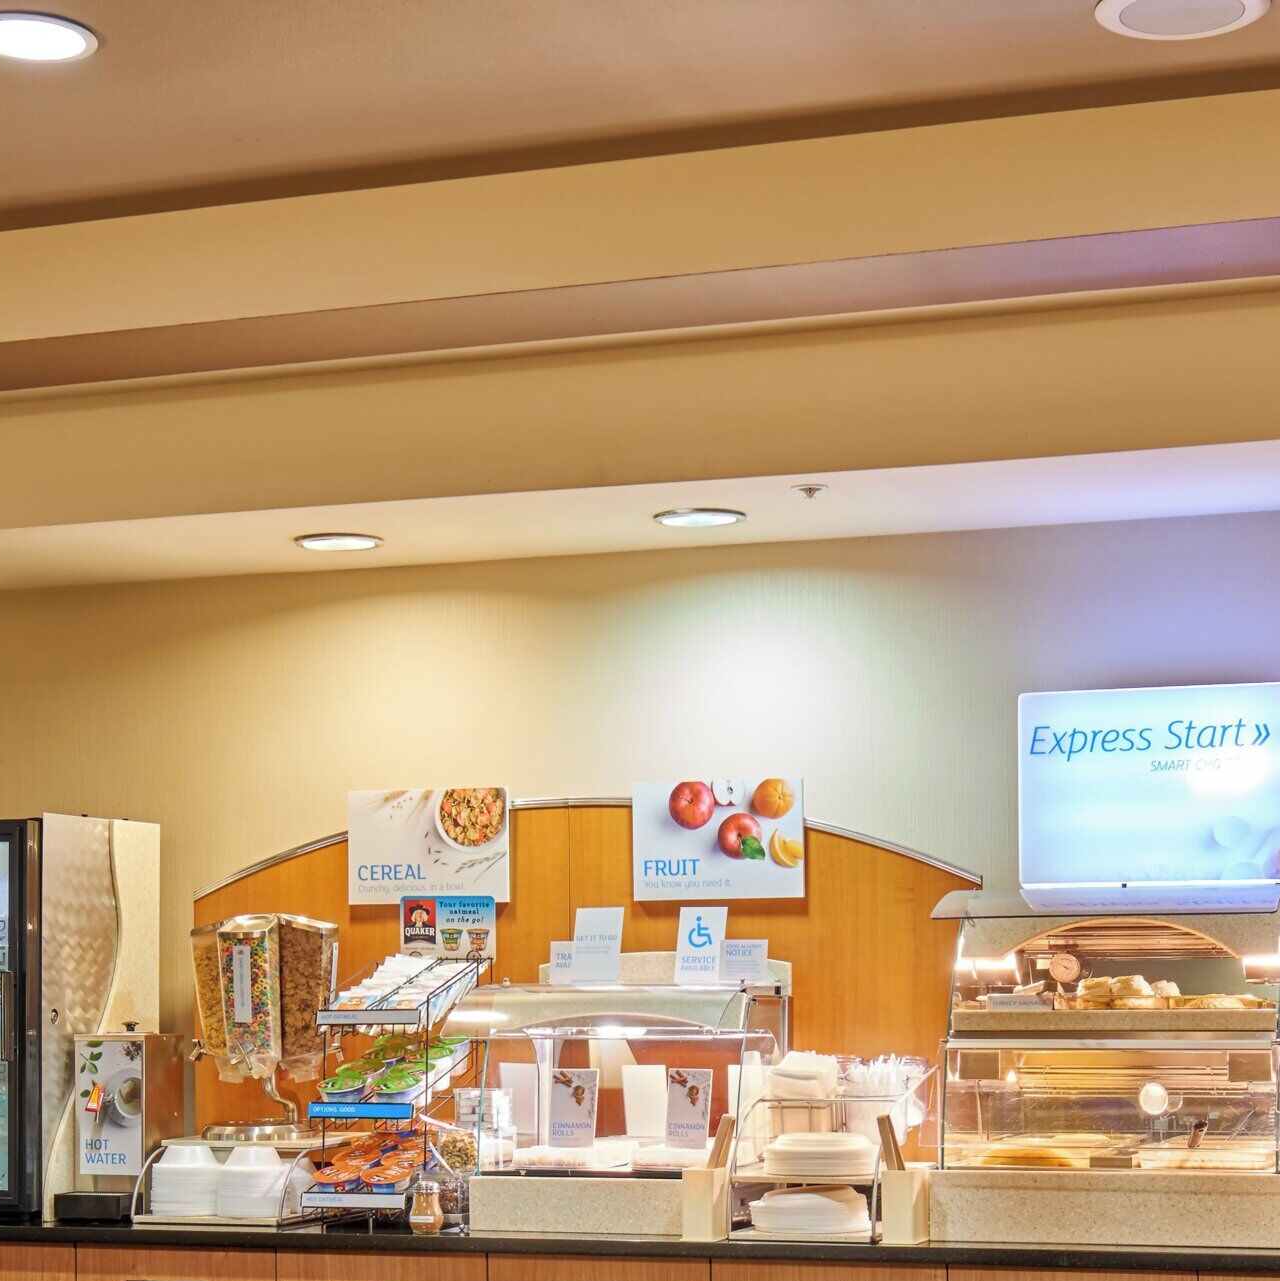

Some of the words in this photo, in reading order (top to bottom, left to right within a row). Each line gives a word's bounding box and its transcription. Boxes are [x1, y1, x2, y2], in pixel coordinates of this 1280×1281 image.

[1030, 726, 1152, 762] Express
[1164, 718, 1246, 749] Start
[1151, 759, 1190, 771] SMART
[358, 864, 426, 880] CEREAL
[644, 859, 700, 876] FRUIT
[358, 884, 392, 894] Crunchy,
[393, 883, 428, 892] delicious,
[685, 881, 699, 889] you
[703, 879, 722, 887] need
[405, 927, 435, 936] QUAKER
[86, 1139, 109, 1150] HOT
[86, 1153, 126, 1164] WATER
